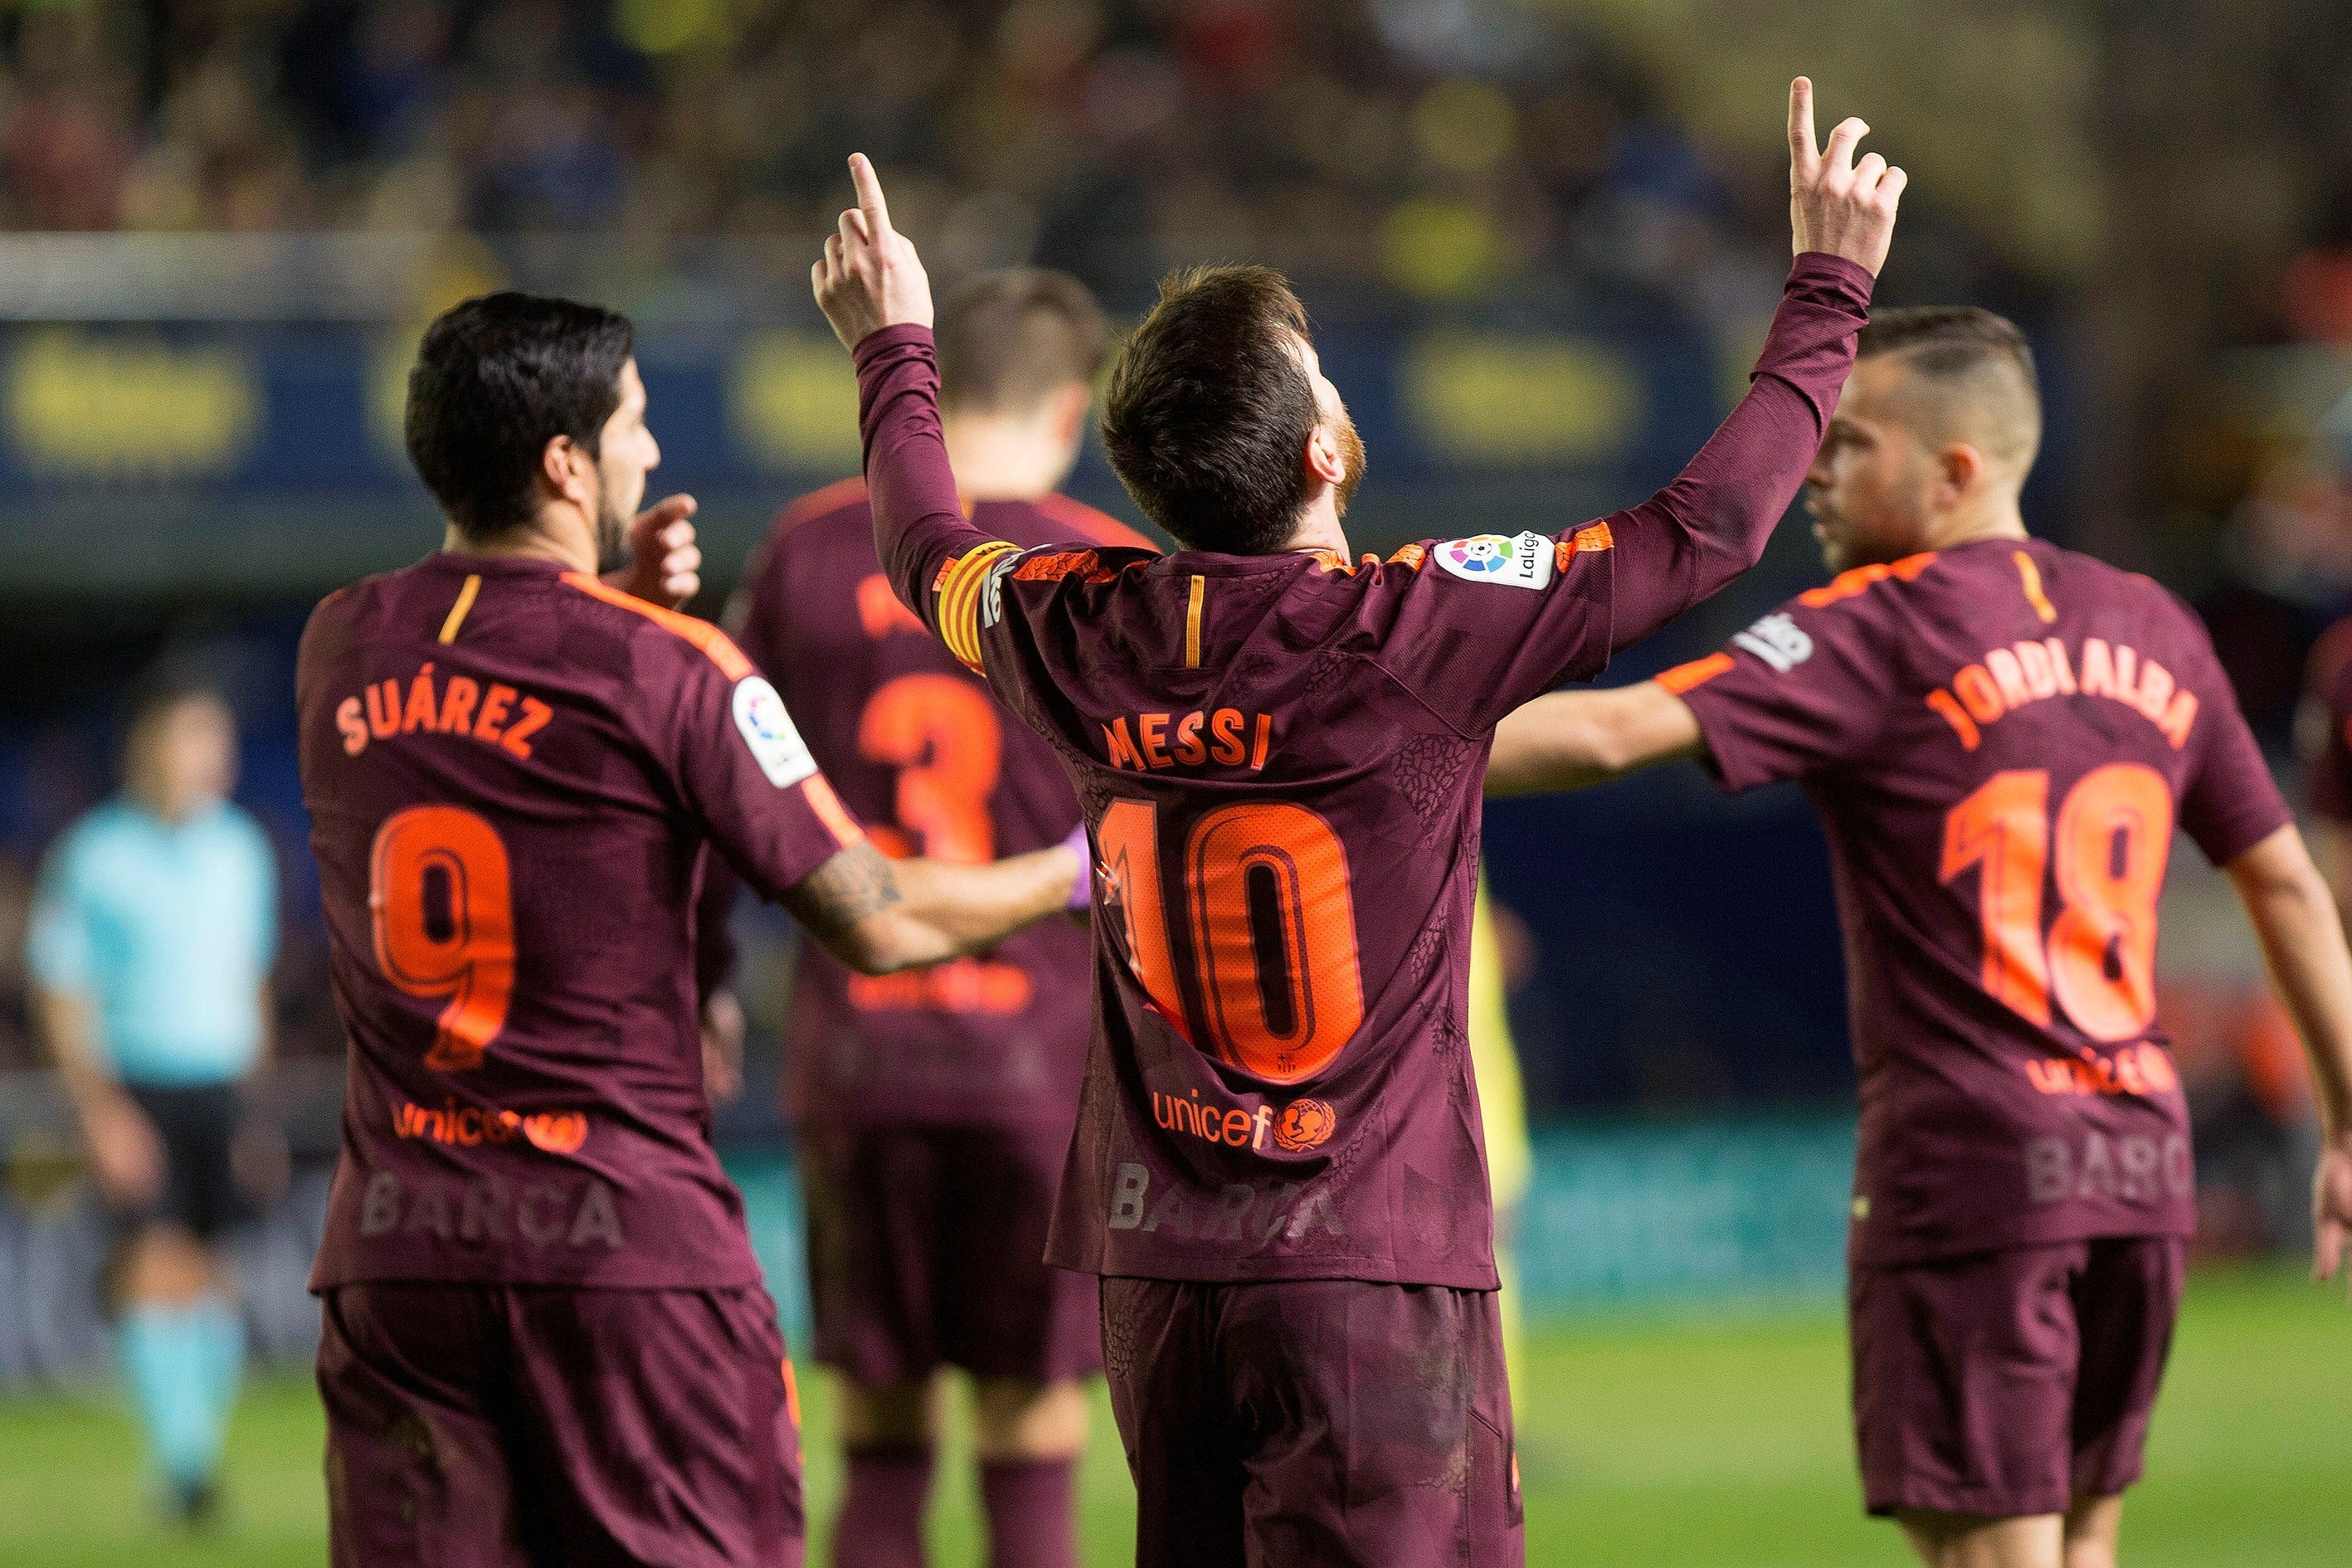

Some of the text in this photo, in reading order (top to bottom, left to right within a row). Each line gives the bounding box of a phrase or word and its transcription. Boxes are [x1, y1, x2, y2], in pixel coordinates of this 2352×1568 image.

[335, 661, 554, 761] SUÁREZ
[1101, 708, 1272, 772] MESSI
[1925, 636, 2077, 752] JORDI
[2079, 636, 2199, 752] ALBA
[368, 802, 516, 1073] 9
[1096, 796, 1367, 1085] 10
[1939, 762, 2174, 1043] 18
[1153, 1088, 1273, 1151] unicef
